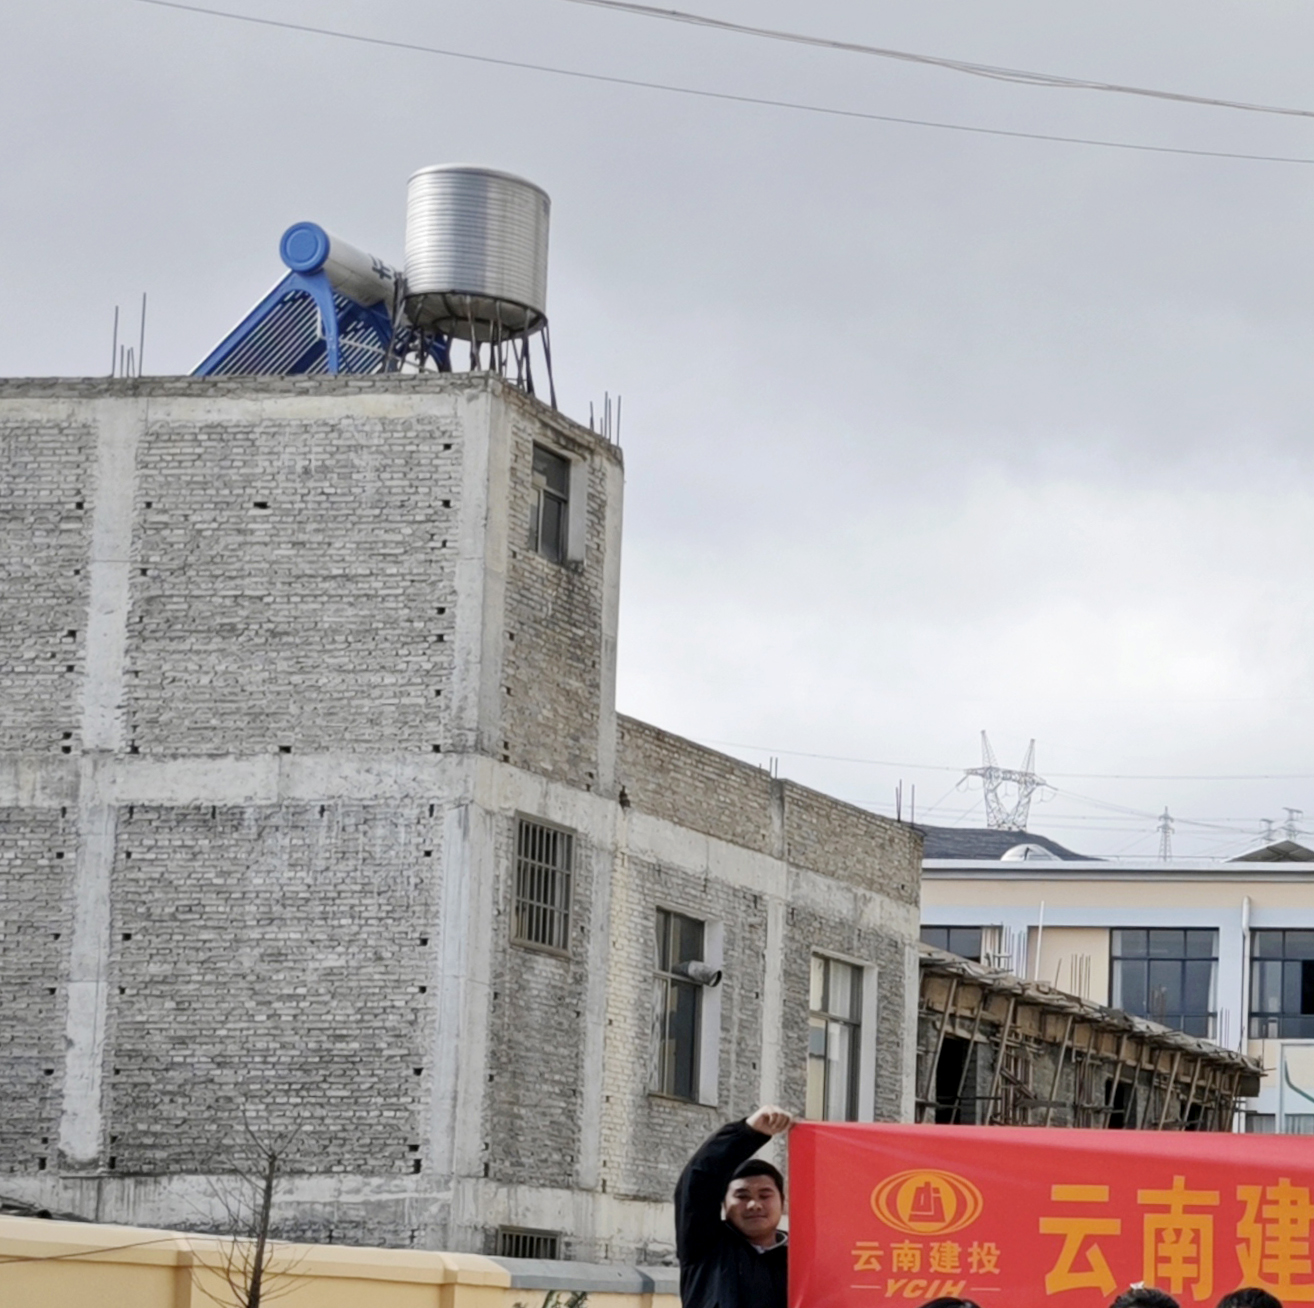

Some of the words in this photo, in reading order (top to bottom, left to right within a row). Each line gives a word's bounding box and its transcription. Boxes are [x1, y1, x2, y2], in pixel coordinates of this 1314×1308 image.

[850, 1240, 1001, 1274] 云南建投
[884, 1279, 967, 1298] YCIH
